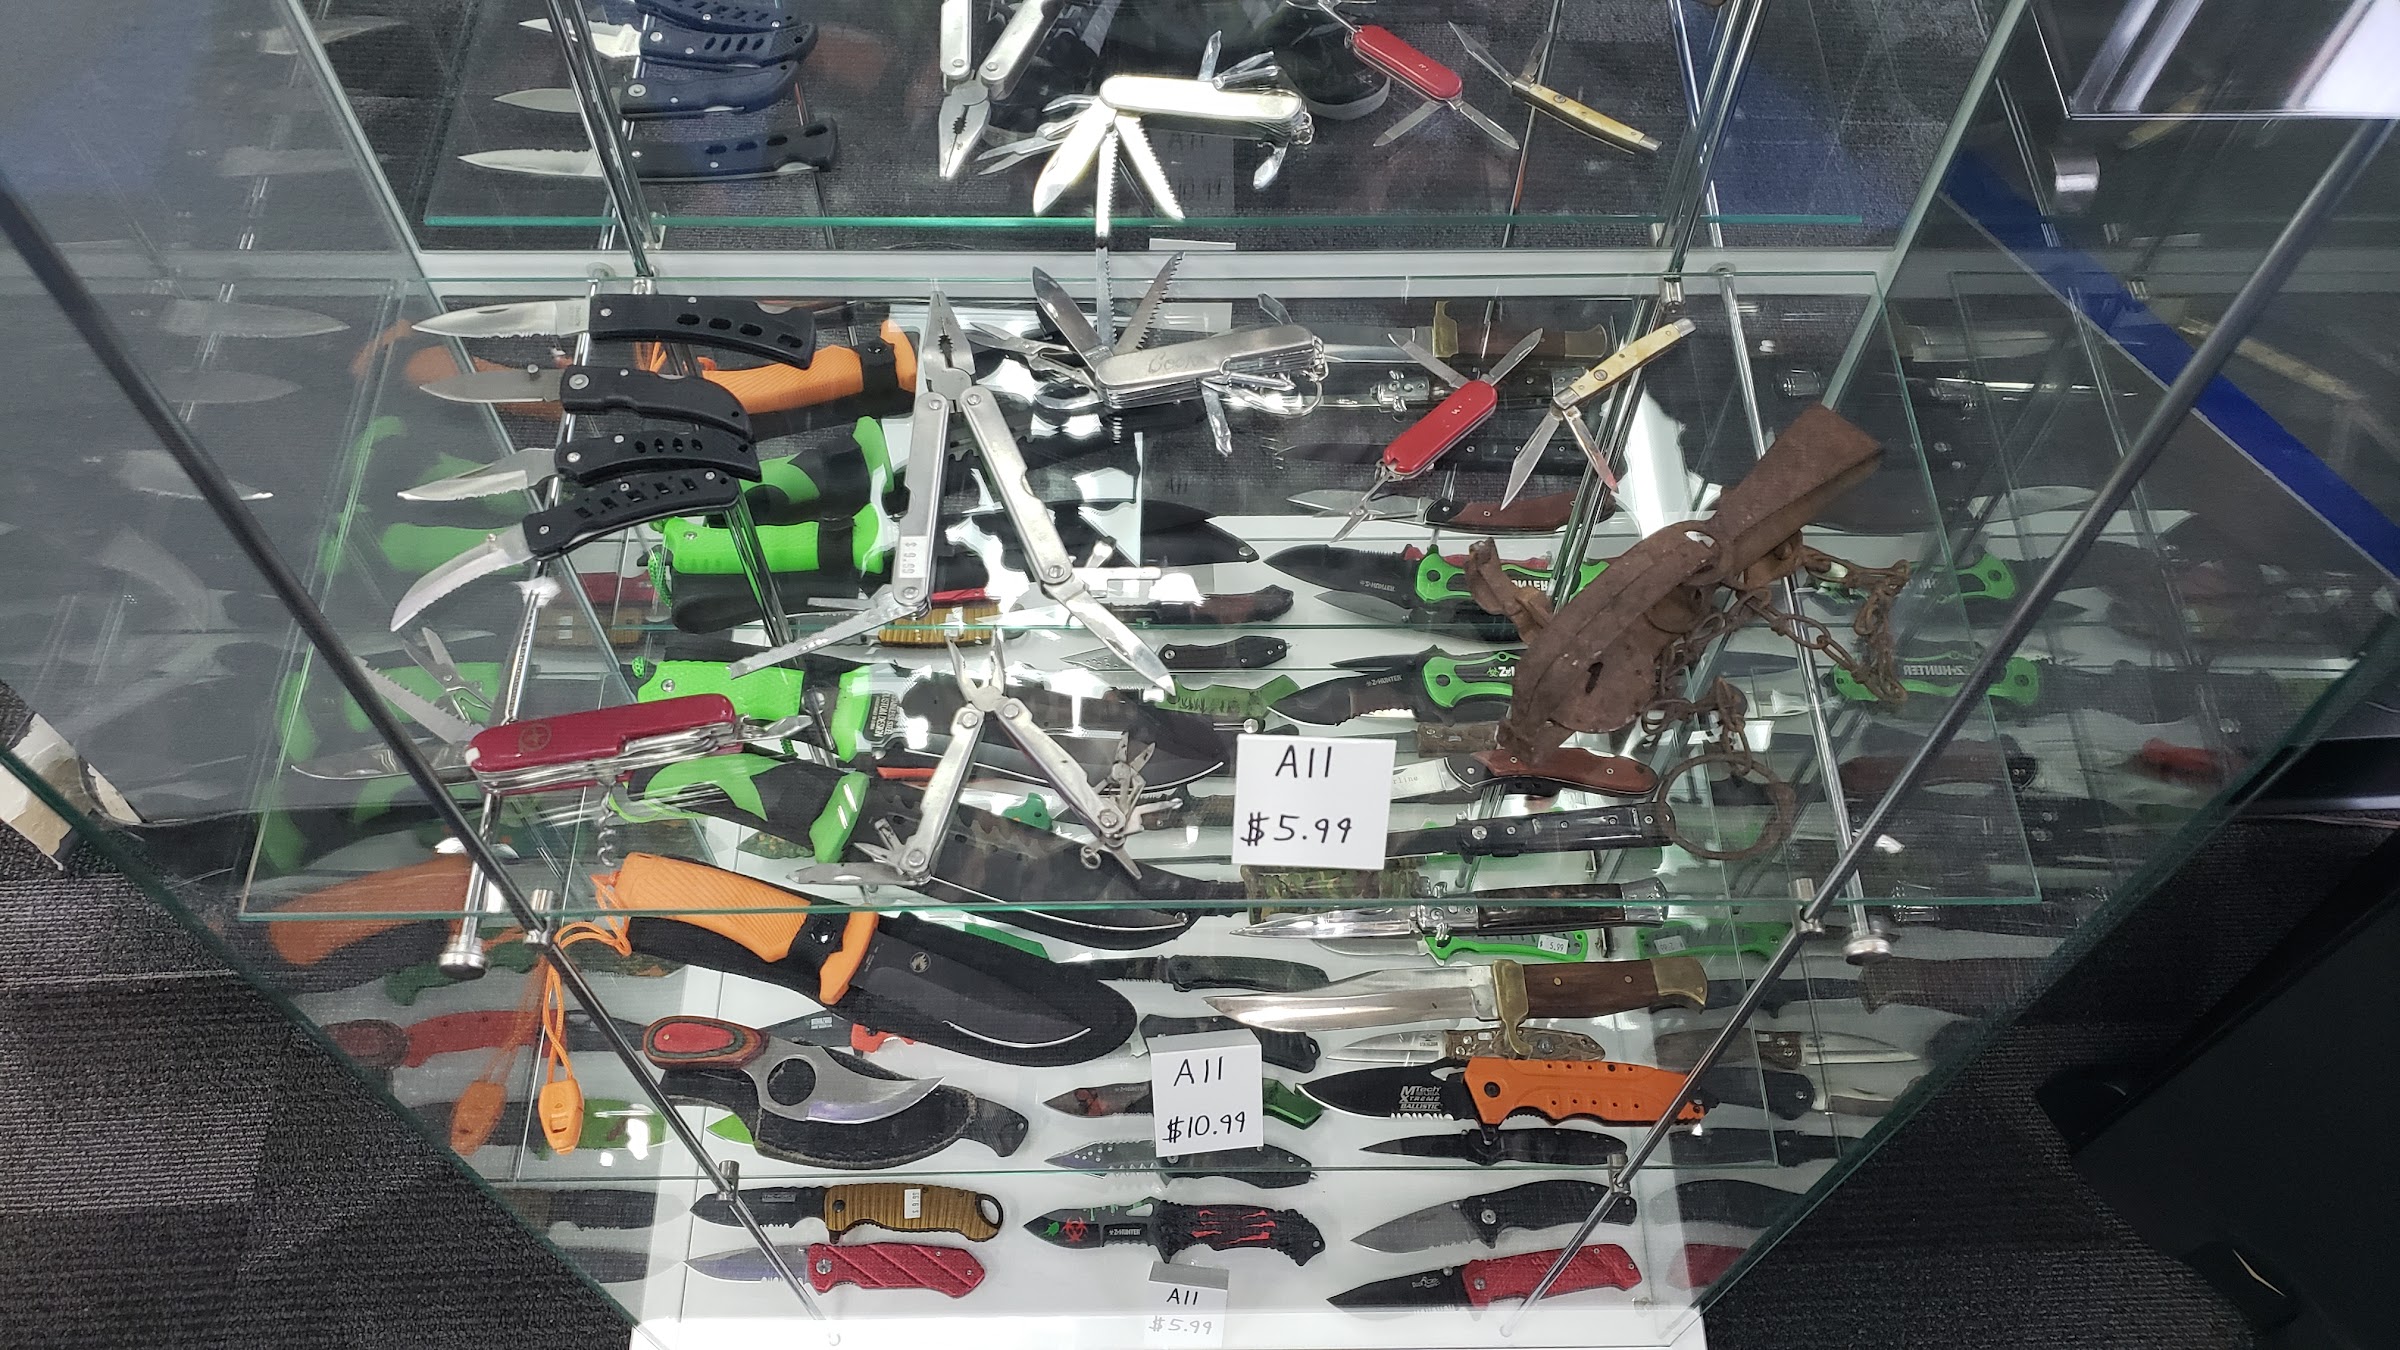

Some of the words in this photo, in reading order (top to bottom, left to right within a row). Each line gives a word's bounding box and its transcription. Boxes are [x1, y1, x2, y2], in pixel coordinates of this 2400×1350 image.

[874, 715, 888, 738] DESIGN
[1275, 744, 1332, 778] All
[1240, 812, 1352, 847] $5.99
[1173, 1056, 1223, 1087] All
[1162, 1111, 1245, 1143] $10.99
[1166, 1287, 1198, 1305] All
[1148, 1316, 1212, 1335] $5.99
